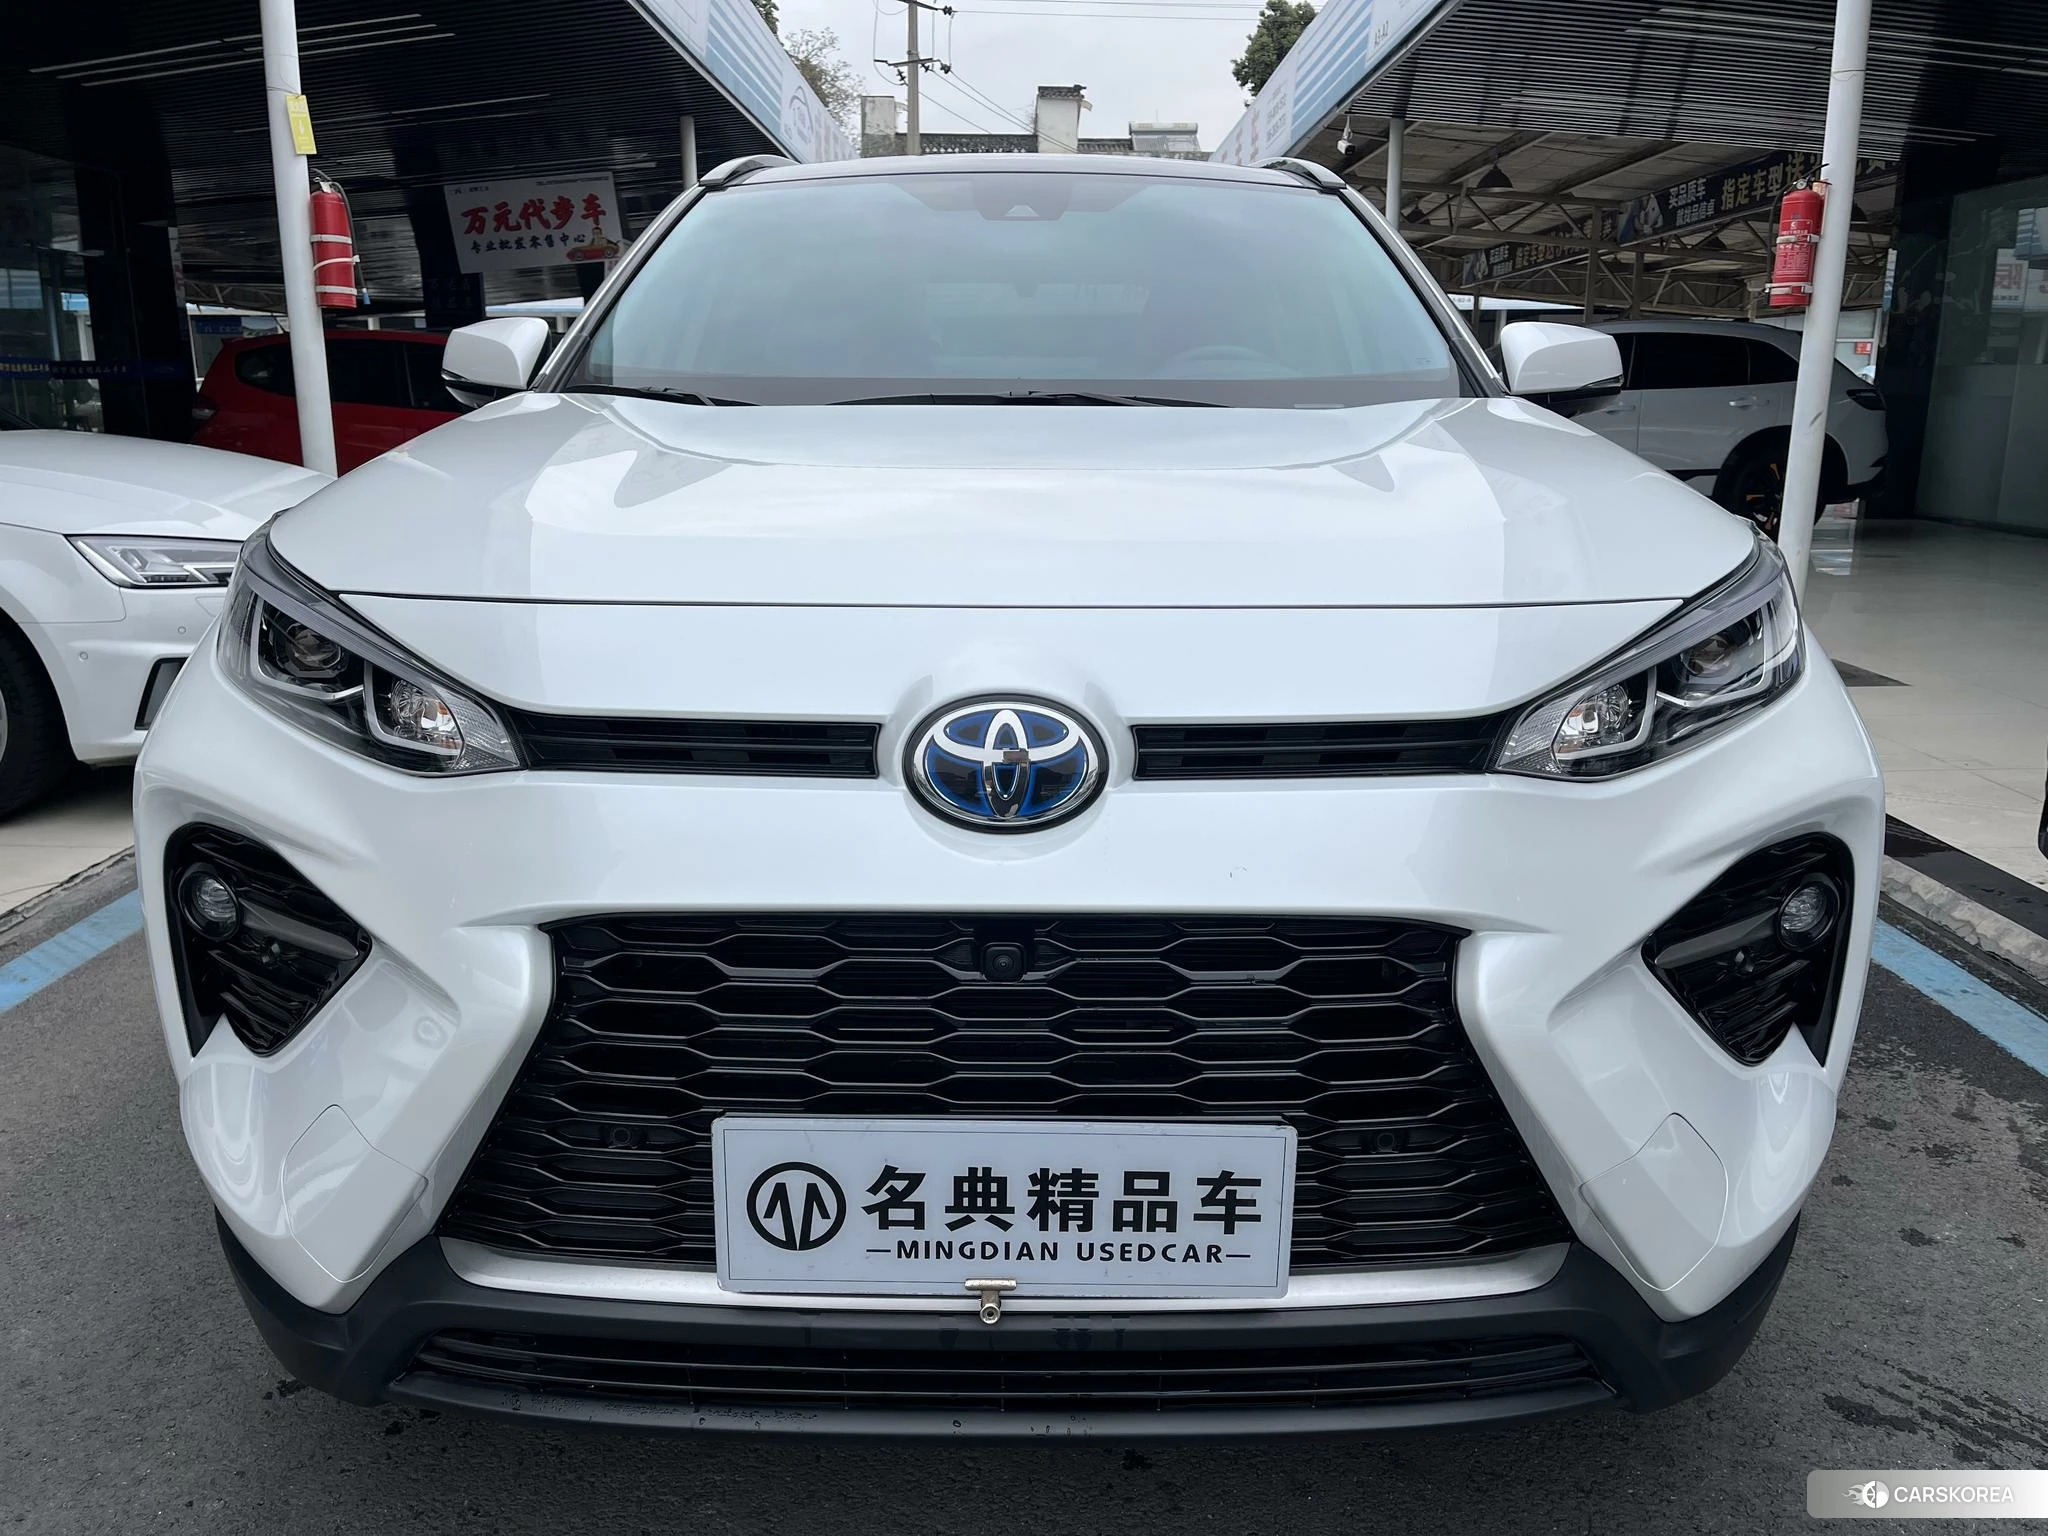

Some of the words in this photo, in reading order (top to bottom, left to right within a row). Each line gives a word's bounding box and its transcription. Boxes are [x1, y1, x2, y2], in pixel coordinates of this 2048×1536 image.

[1668, 177, 1707, 209] 买品质车
[461, 193, 606, 235] 万元代步车
[471, 232, 586, 254] 专业批发零售中心
[861, 1164, 1262, 1235] 名典精品车
[897, 1240, 1058, 1261] MINGDIAN
[1076, 1243, 1223, 1264] USEDCAR
